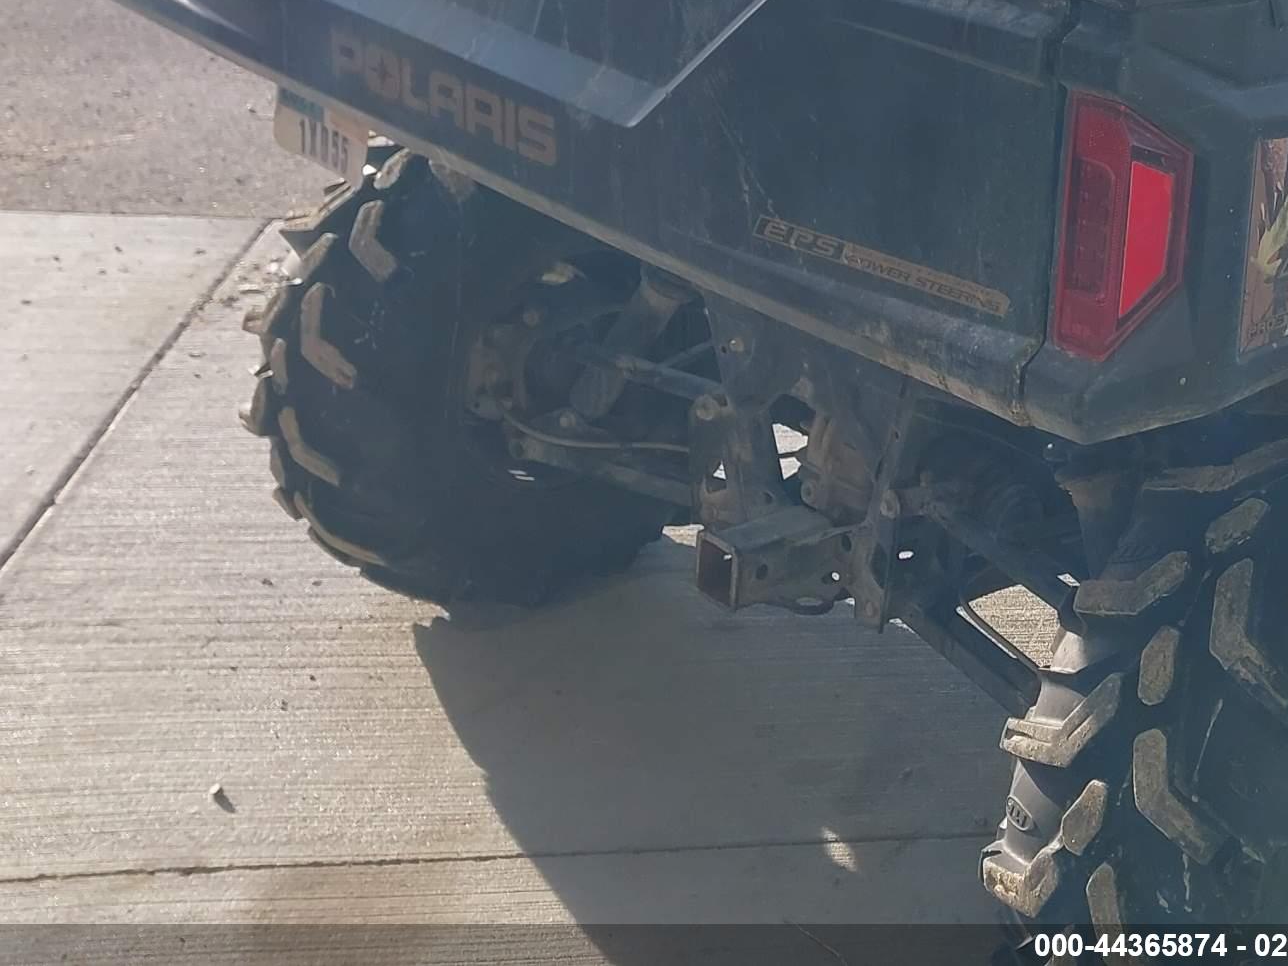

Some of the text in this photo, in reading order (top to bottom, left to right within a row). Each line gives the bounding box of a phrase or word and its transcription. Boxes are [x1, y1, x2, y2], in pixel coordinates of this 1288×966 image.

[330, 26, 557, 166] POLARIS
[763, 219, 839, 257] EPS
[848, 255, 910, 282] POWER
[914, 277, 1002, 311] STEERING
